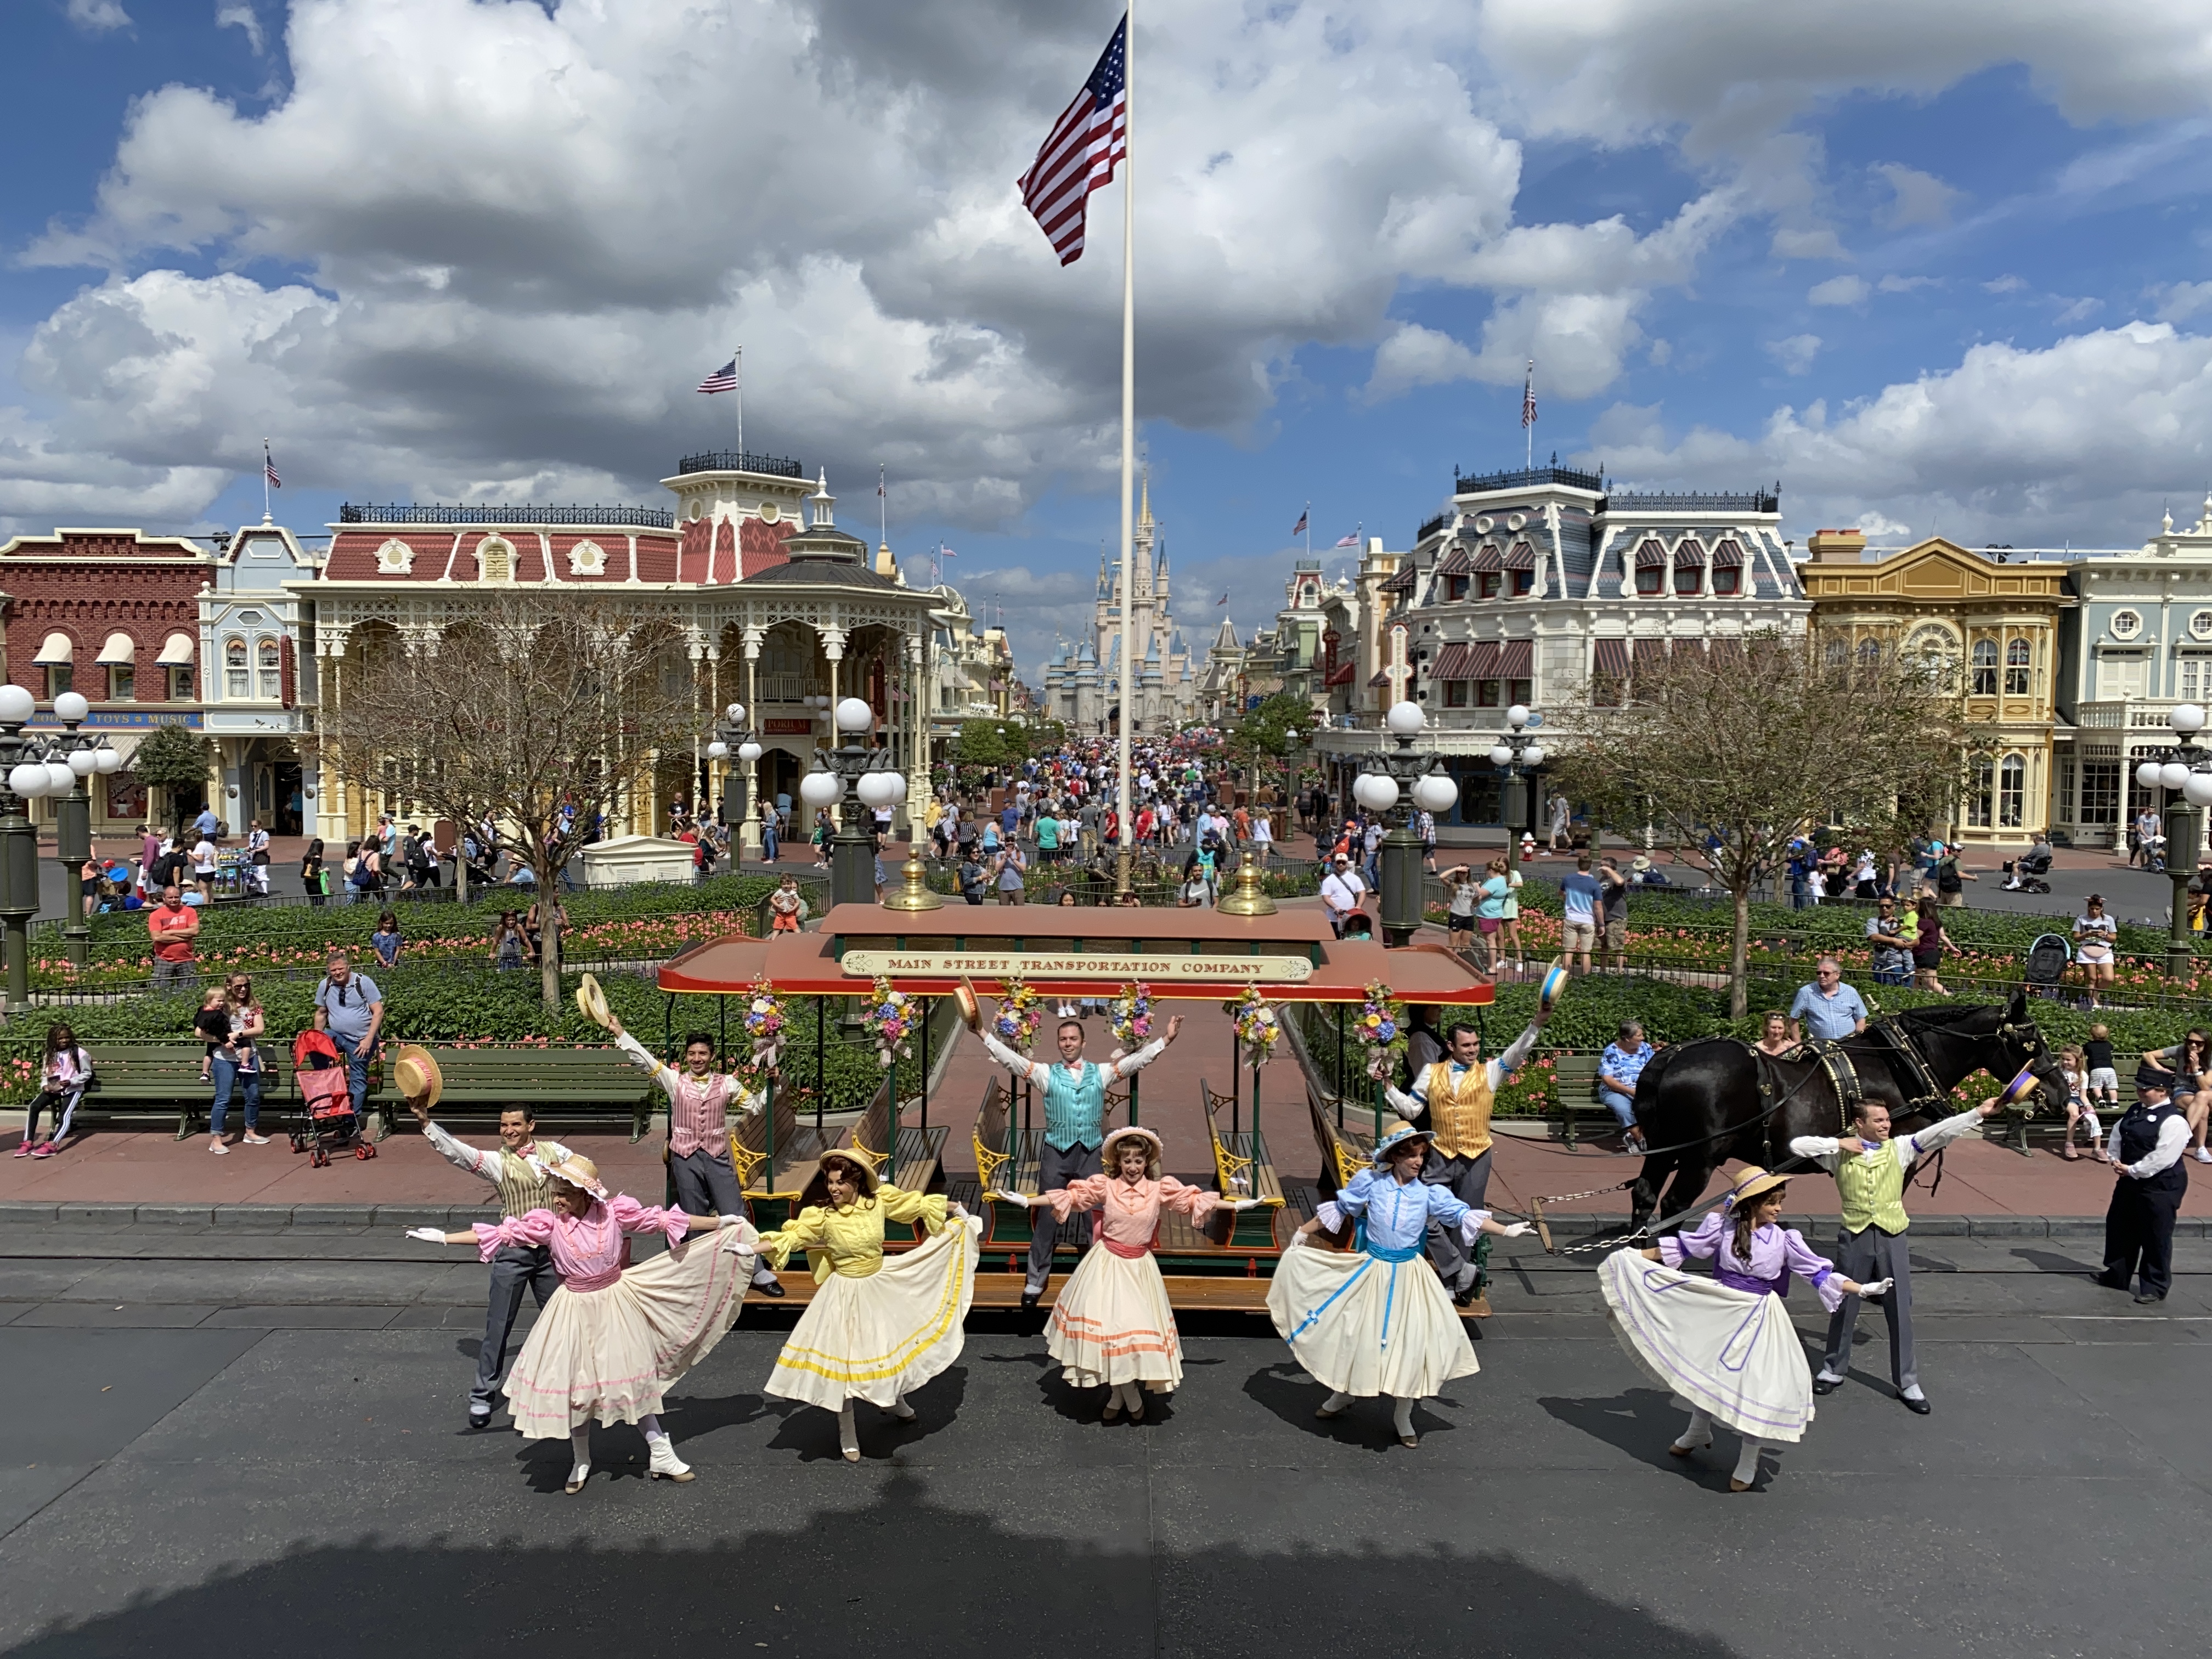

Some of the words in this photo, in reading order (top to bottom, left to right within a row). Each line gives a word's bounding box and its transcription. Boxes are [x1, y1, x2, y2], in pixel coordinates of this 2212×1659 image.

[32, 714, 63, 723] BOO
[94, 714, 129, 723] TOYS
[148, 714, 191, 724] MUSIC
[765, 719, 806, 729] PORIUM
[888, 958, 932, 969] MAIN
[943, 959, 1010, 970] STREET
[1019, 960, 1171, 972] TRANSPORTATION
[1181, 963, 1264, 974] COMPANY
